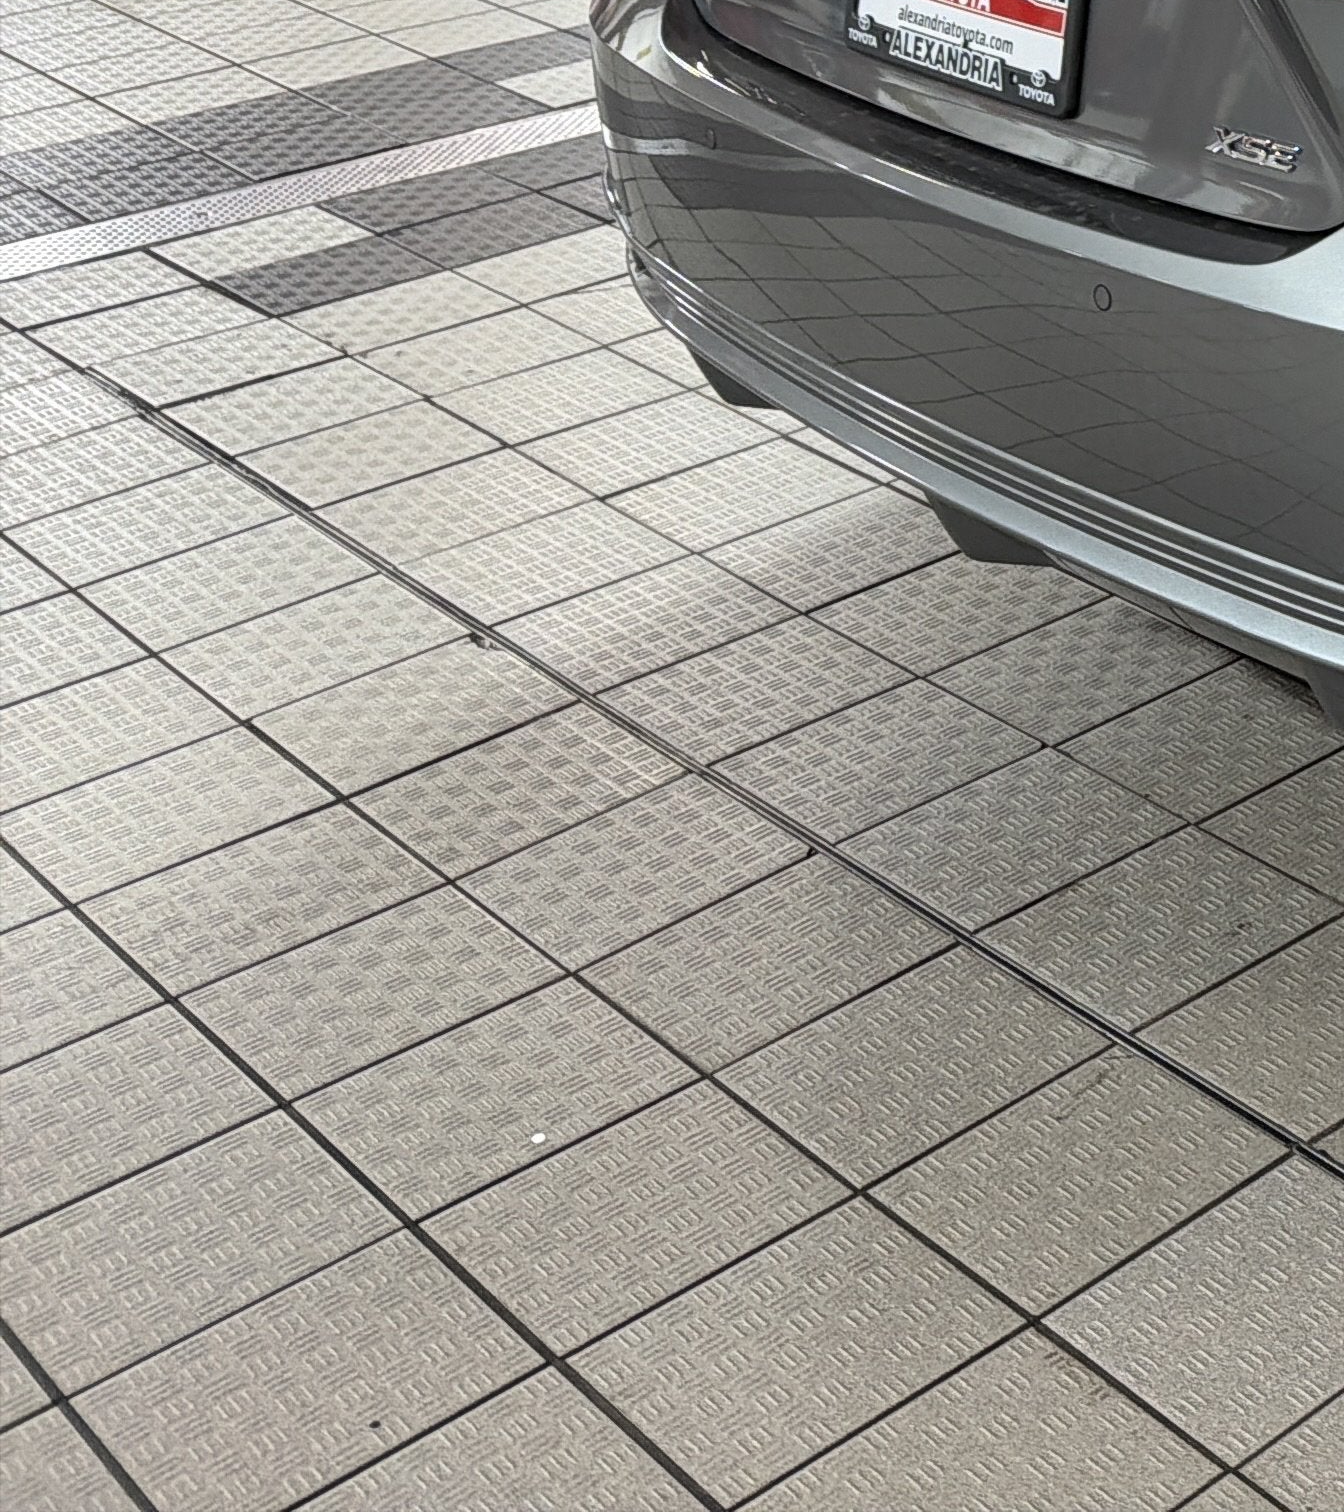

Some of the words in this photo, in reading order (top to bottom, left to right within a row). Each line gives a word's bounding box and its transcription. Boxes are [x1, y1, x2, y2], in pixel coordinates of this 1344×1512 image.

[848, 27, 878, 49] TOYOTA
[898, 4, 1014, 56] alexandriatoyota.com
[889, 29, 1003, 92] ALEXANDRIA
[1018, 83, 1056, 107] TOYOTA
[1204, 126, 1302, 174] XSE
